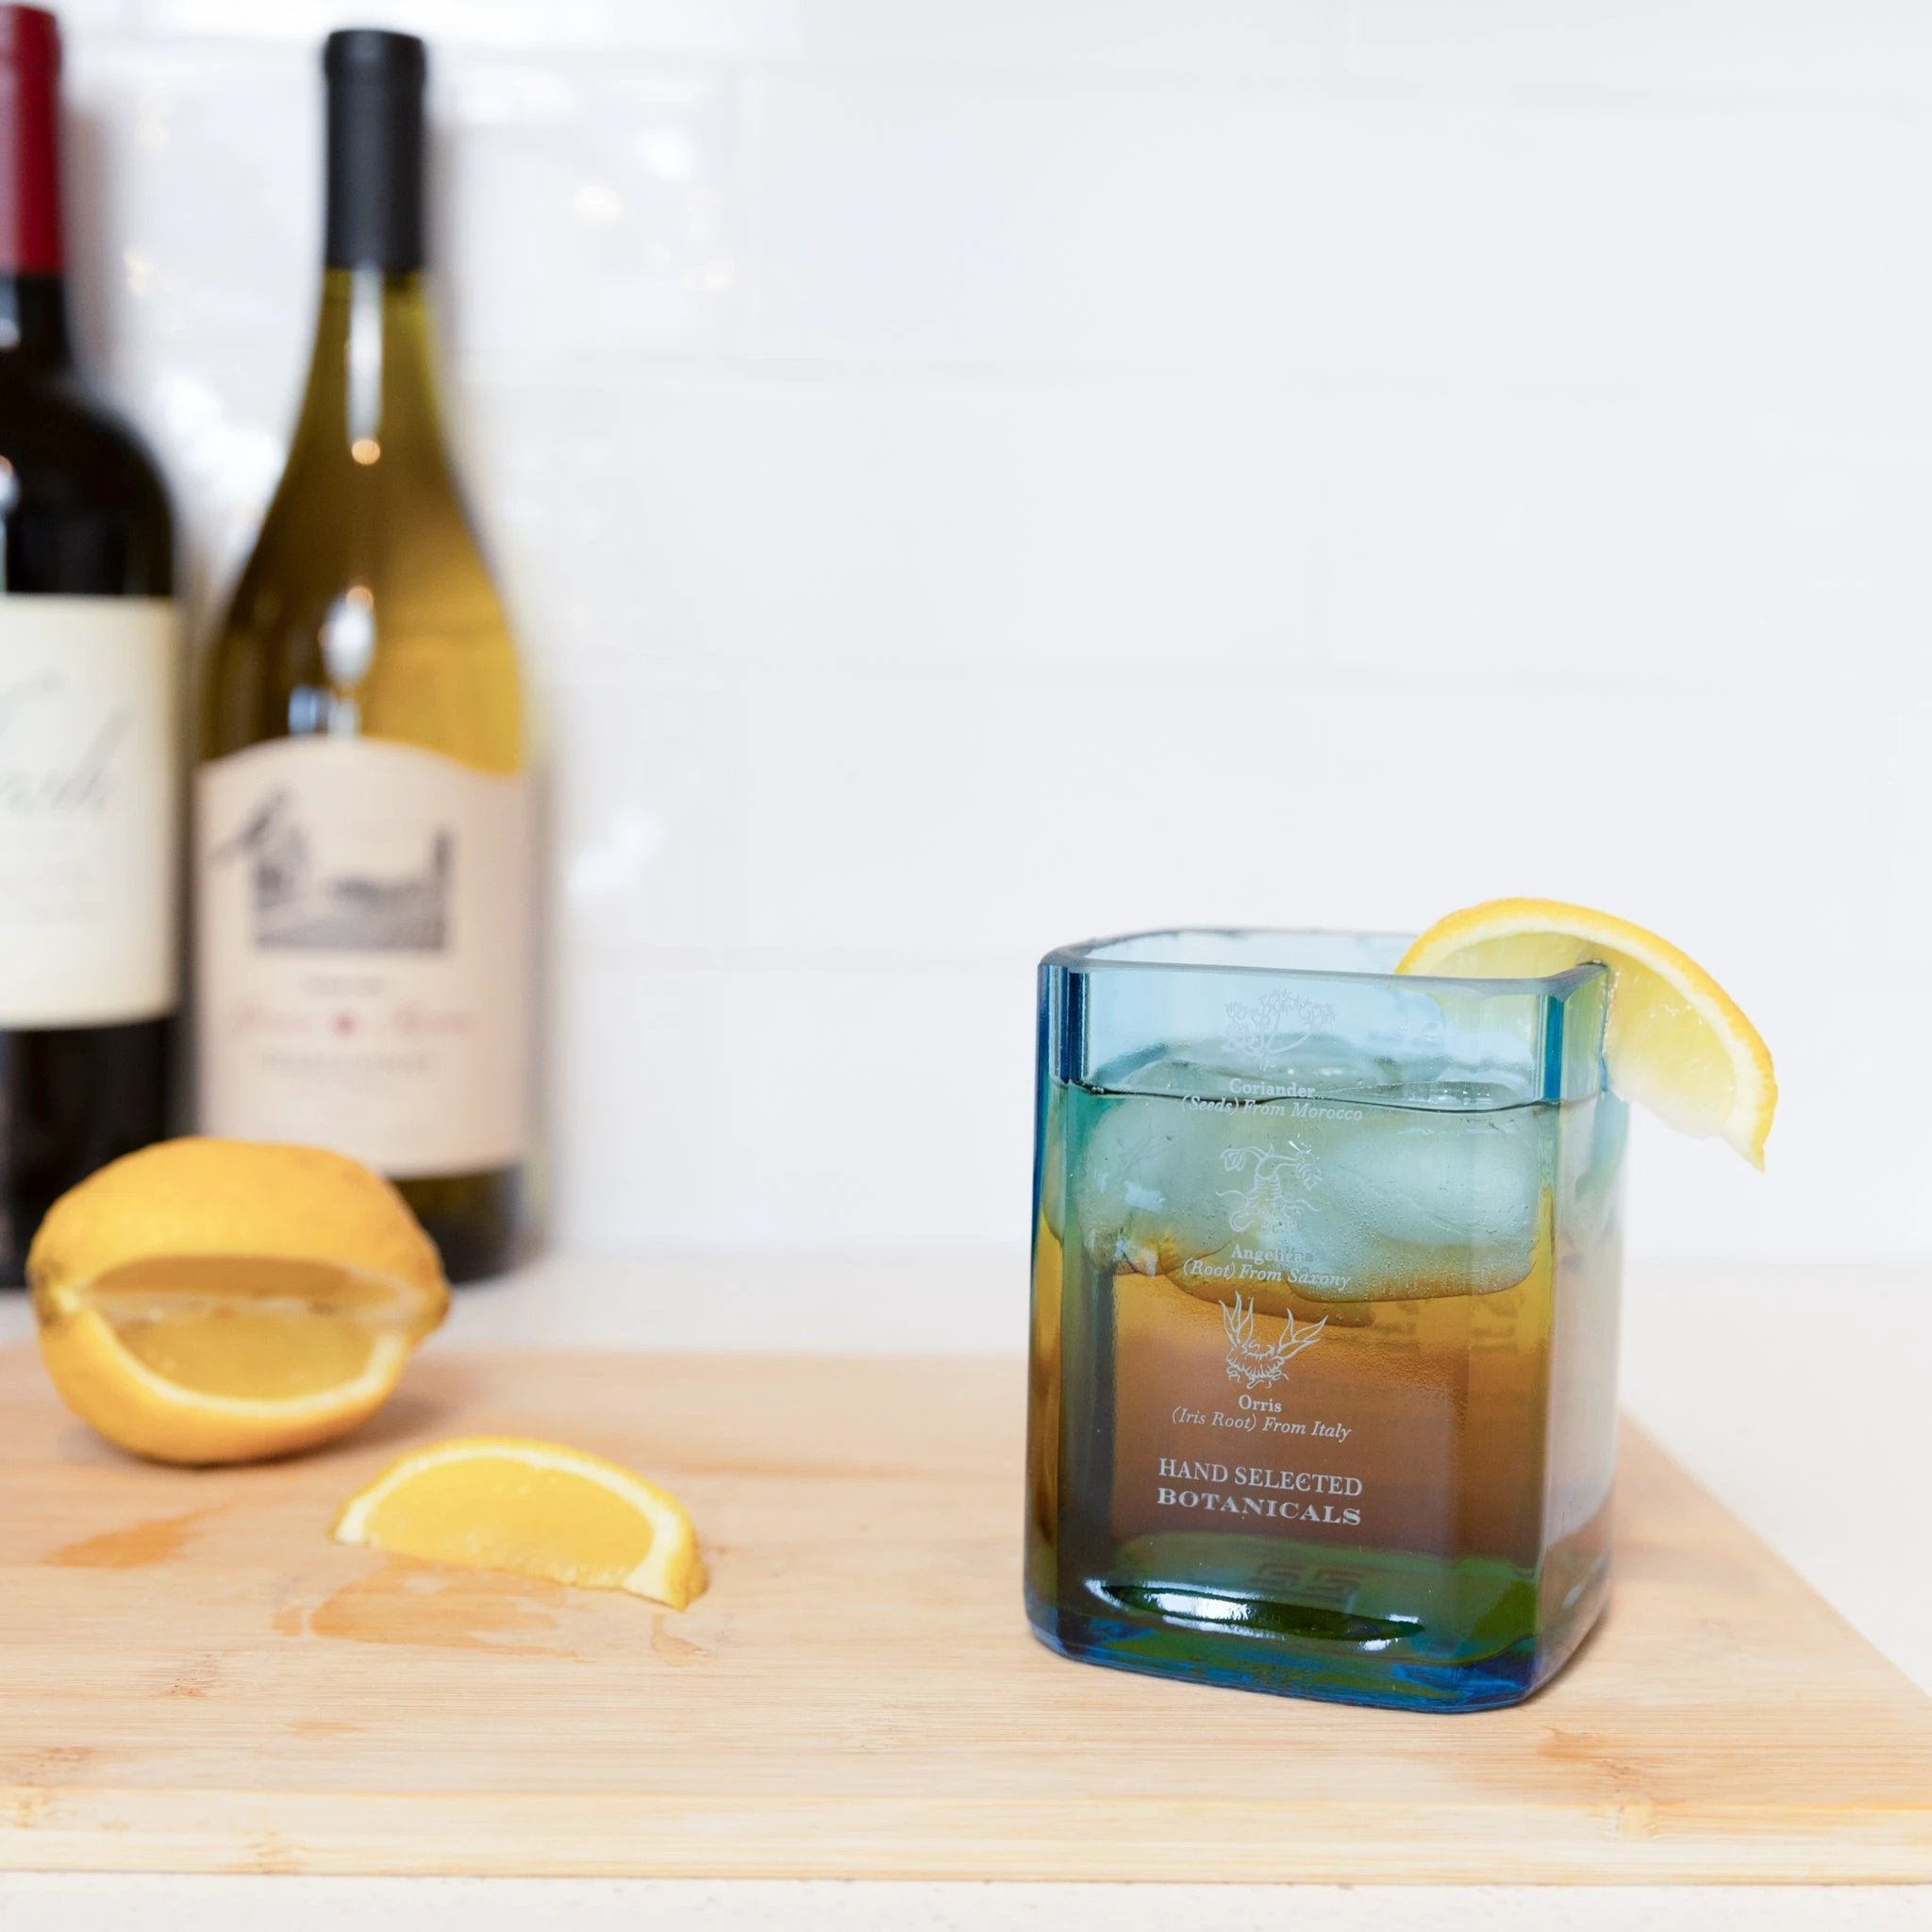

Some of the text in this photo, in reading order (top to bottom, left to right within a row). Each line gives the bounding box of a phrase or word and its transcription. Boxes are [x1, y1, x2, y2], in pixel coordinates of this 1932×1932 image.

[1229, 1077, 1315, 1097] Coriander
[1181, 1094, 1363, 1121] (Seeds) From Morocco
[1231, 1243, 1303, 1264] Angelica
[1182, 1257, 1351, 1291] (Root) From Saxony
[1238, 1394, 1283, 1413] Orris
[1172, 1406, 1352, 1443] (Iris Root) From Italy
[1158, 1457, 1363, 1497] HAND SELECTED
[1157, 1487, 1362, 1526] BOTANICALS
